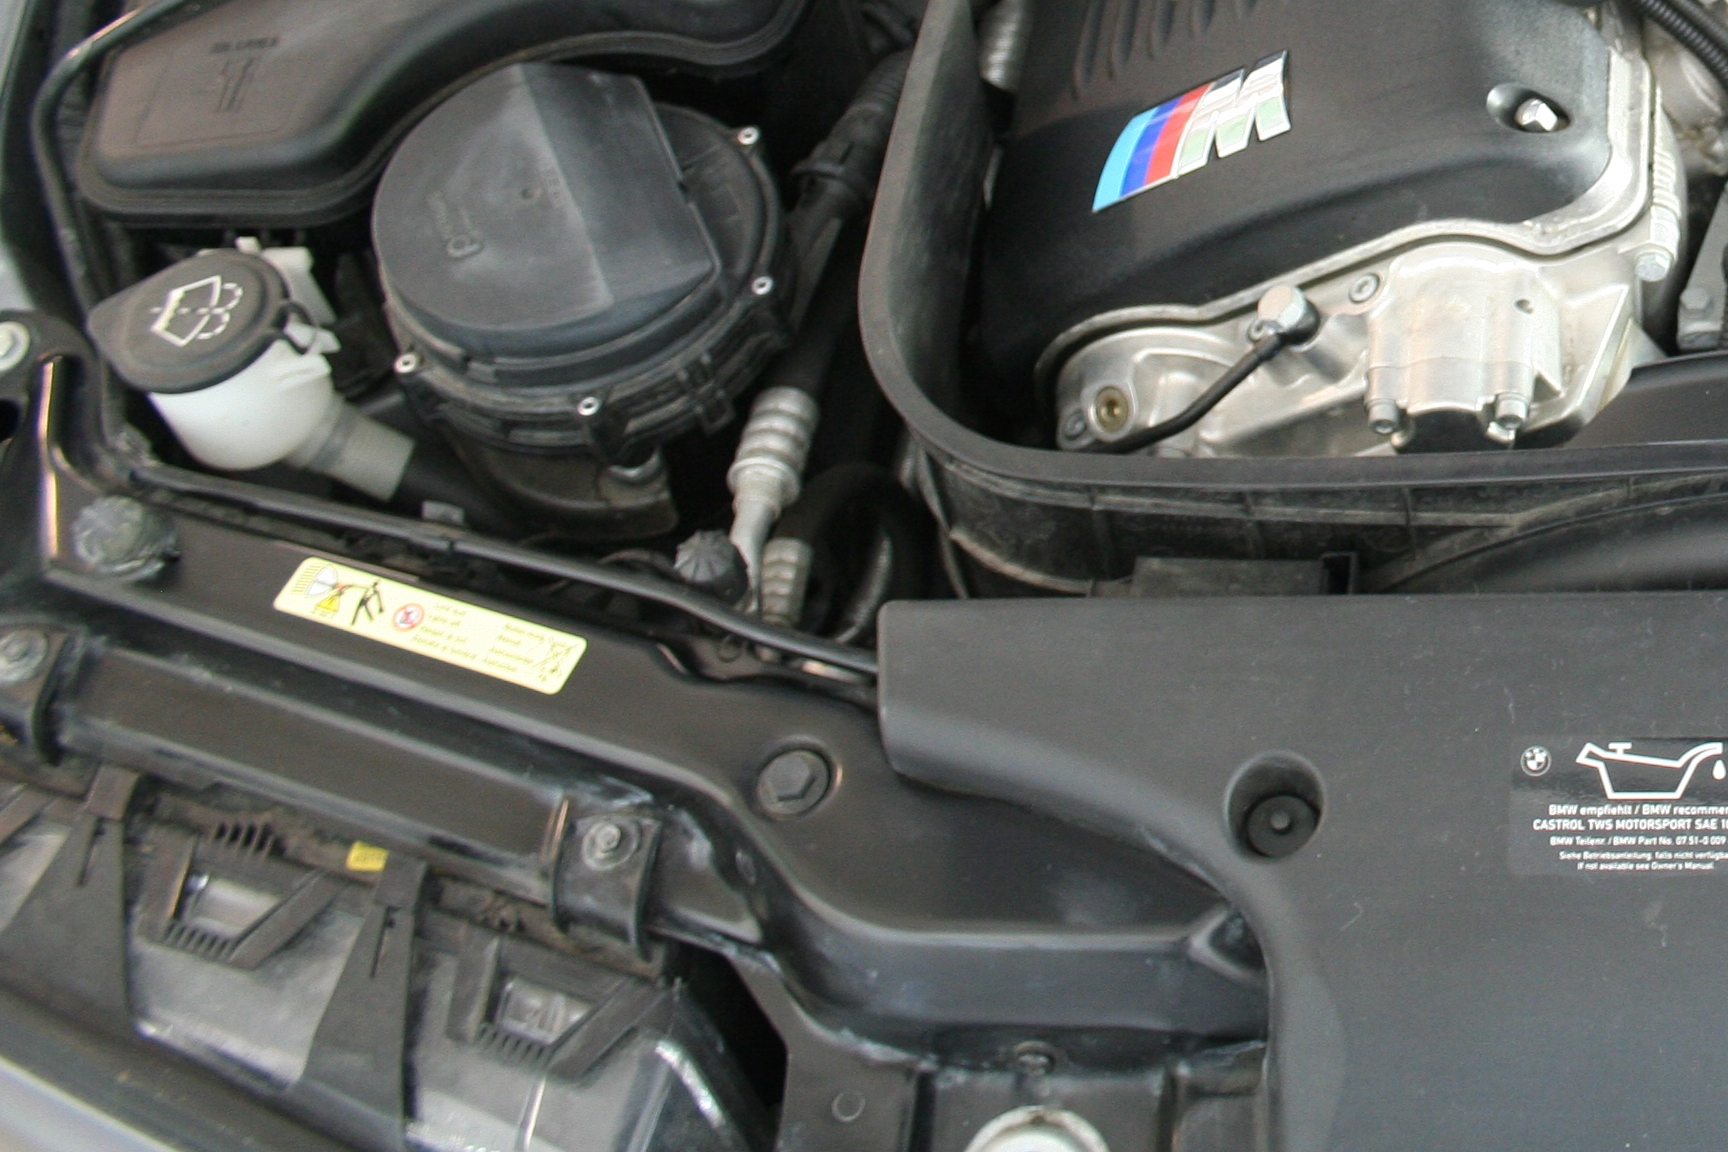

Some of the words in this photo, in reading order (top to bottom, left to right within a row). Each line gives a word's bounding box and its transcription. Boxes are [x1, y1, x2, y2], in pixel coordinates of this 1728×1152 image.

[1548, 804, 1578, 815] BMW
[1641, 804, 1671, 814] BMW
[1533, 819, 1585, 830] CASTROL
[1587, 819, 1613, 830] TWS
[1615, 819, 1691, 830] MOTORSPORT
[1695, 819, 1717, 829] SAE
[1549, 836, 1573, 846] BMW
[1613, 836, 1636, 845] BMW
